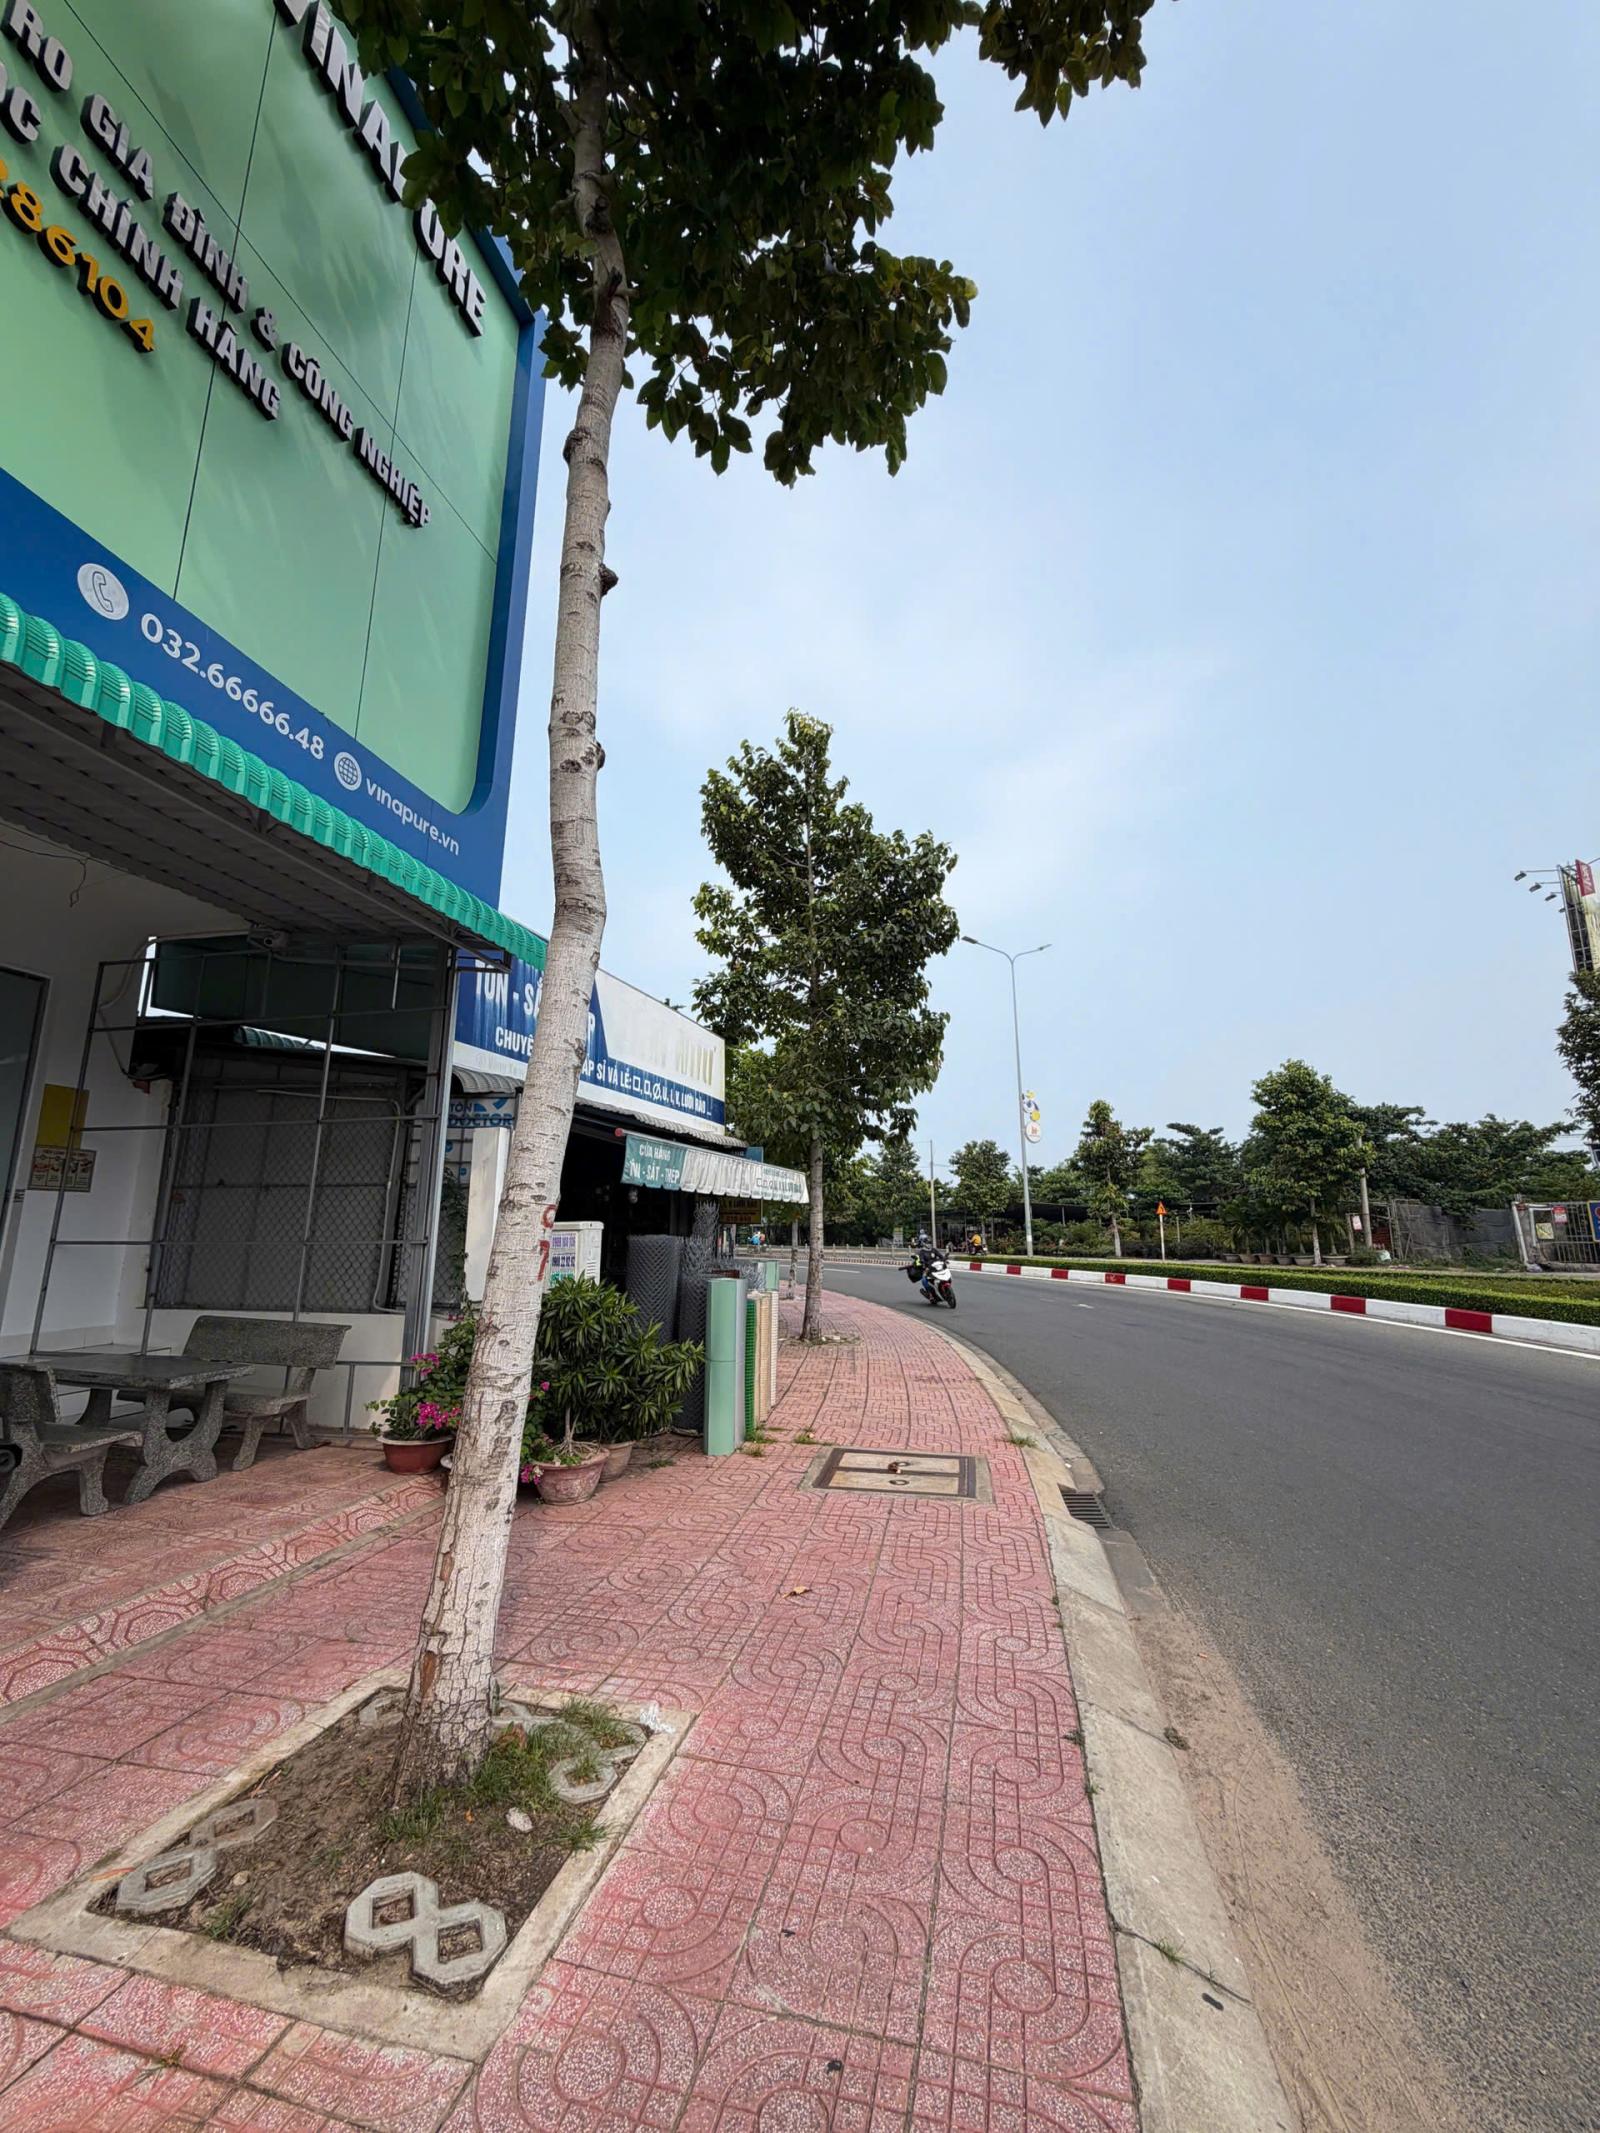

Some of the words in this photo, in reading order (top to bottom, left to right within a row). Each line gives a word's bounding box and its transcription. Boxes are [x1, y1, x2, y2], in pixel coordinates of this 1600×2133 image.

[52, 145, 183, 310] CHÍNH
[188, 297, 281, 420] HÀNG
[84, 94, 154, 199] GIA
[164, 192, 249, 312] ĐÌNH
[252, 307, 278, 351] &
[283, 342, 352, 441] CÔNG
[355, 427, 431, 527] NGHIỆP
[141, 613, 324, 760] 032.66666.48
[366, 778, 460, 856] vinapure.vn
